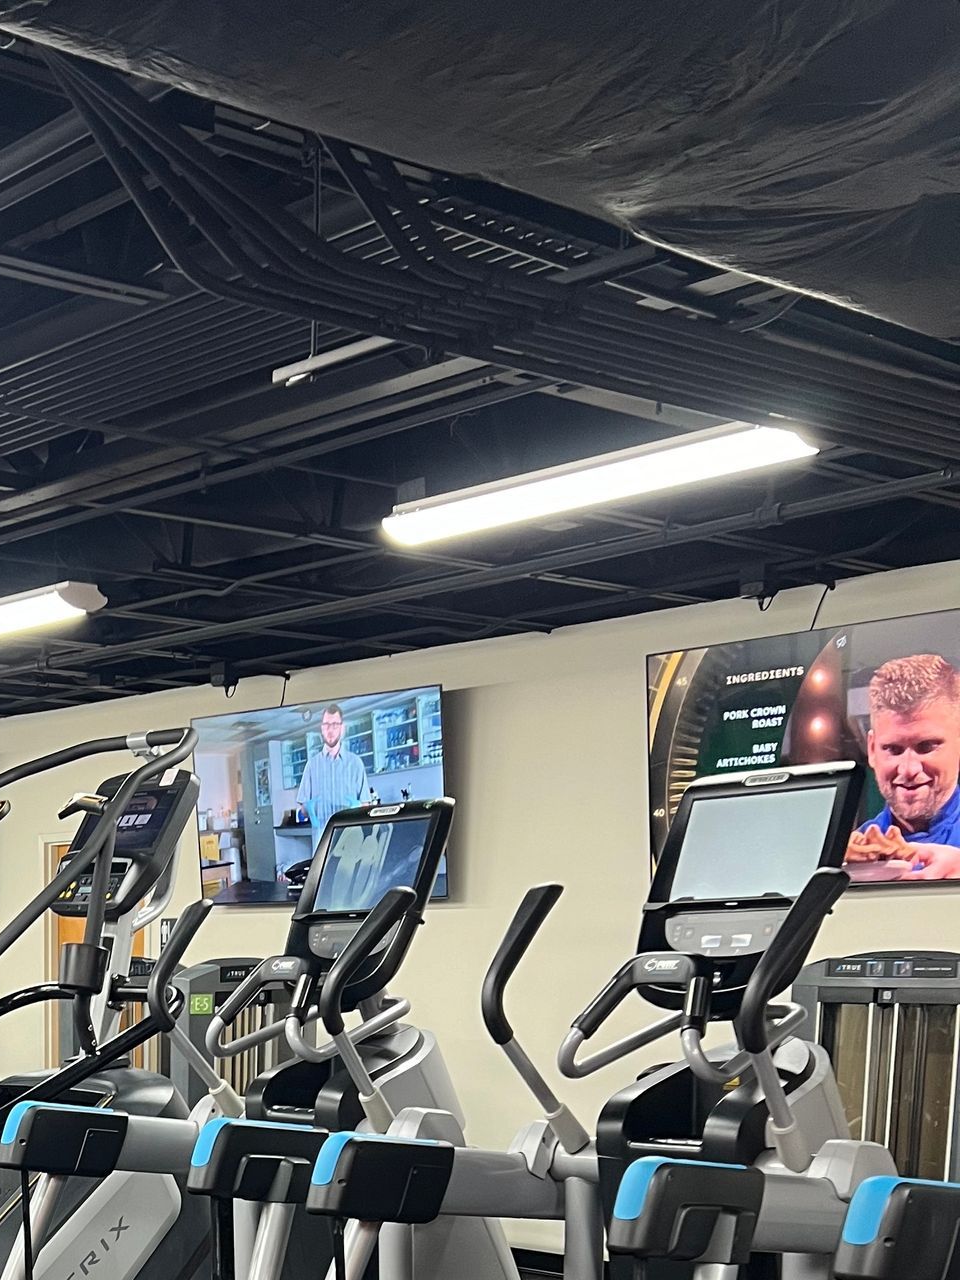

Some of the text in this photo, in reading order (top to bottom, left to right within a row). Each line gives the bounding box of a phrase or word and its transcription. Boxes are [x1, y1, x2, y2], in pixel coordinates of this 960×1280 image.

[676, 677, 688, 686] 45
[726, 666, 804, 685] INGREDIENTS
[723, 705, 786, 721] PORK CROWN
[751, 717, 783, 729] ROAST
[752, 742, 778, 754] BABY
[716, 754, 776, 768] ARTICHOKES
[653, 808, 665, 817] 40
[842, 964, 862, 972] TRUE
[194, 997, 209, 1011] E-5
